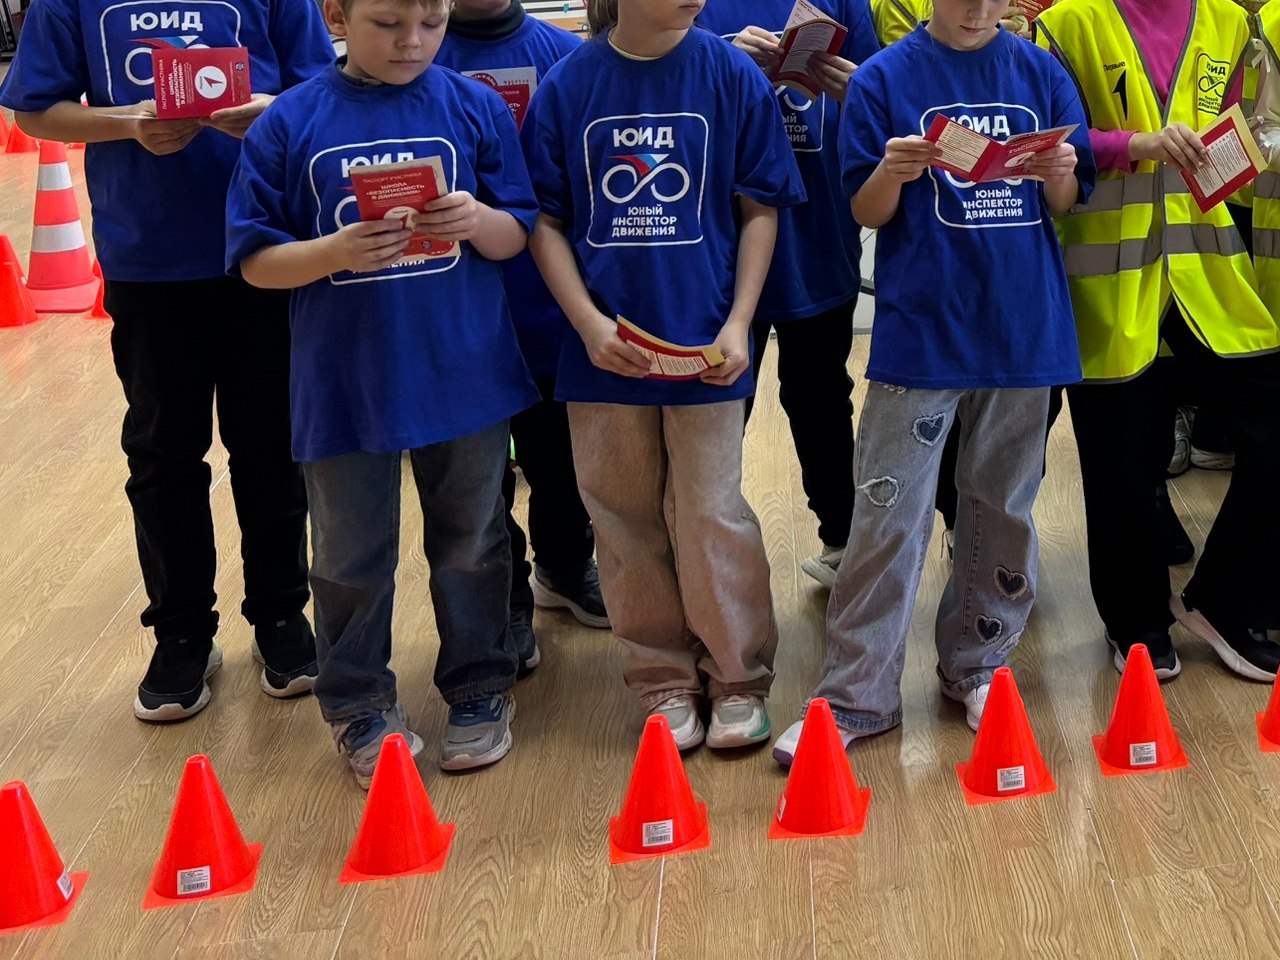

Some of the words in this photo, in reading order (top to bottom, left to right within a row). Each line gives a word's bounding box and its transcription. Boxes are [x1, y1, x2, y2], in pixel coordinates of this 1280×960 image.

[130, 10, 204, 32] ЮИД
[612, 126, 674, 148] ЮИД
[976, 186, 1012, 198] ЮНЫЙ
[962, 199, 1022, 209] ИНСПЕКТОР
[628, 204, 663, 216] ЮНЫЙ
[965, 209, 1023, 220] ДВИЖЕНИЯ
[612, 216, 677, 226] ИНСПЕКТОР
[612, 226, 676, 237] ДВИЖЕНИЯ
